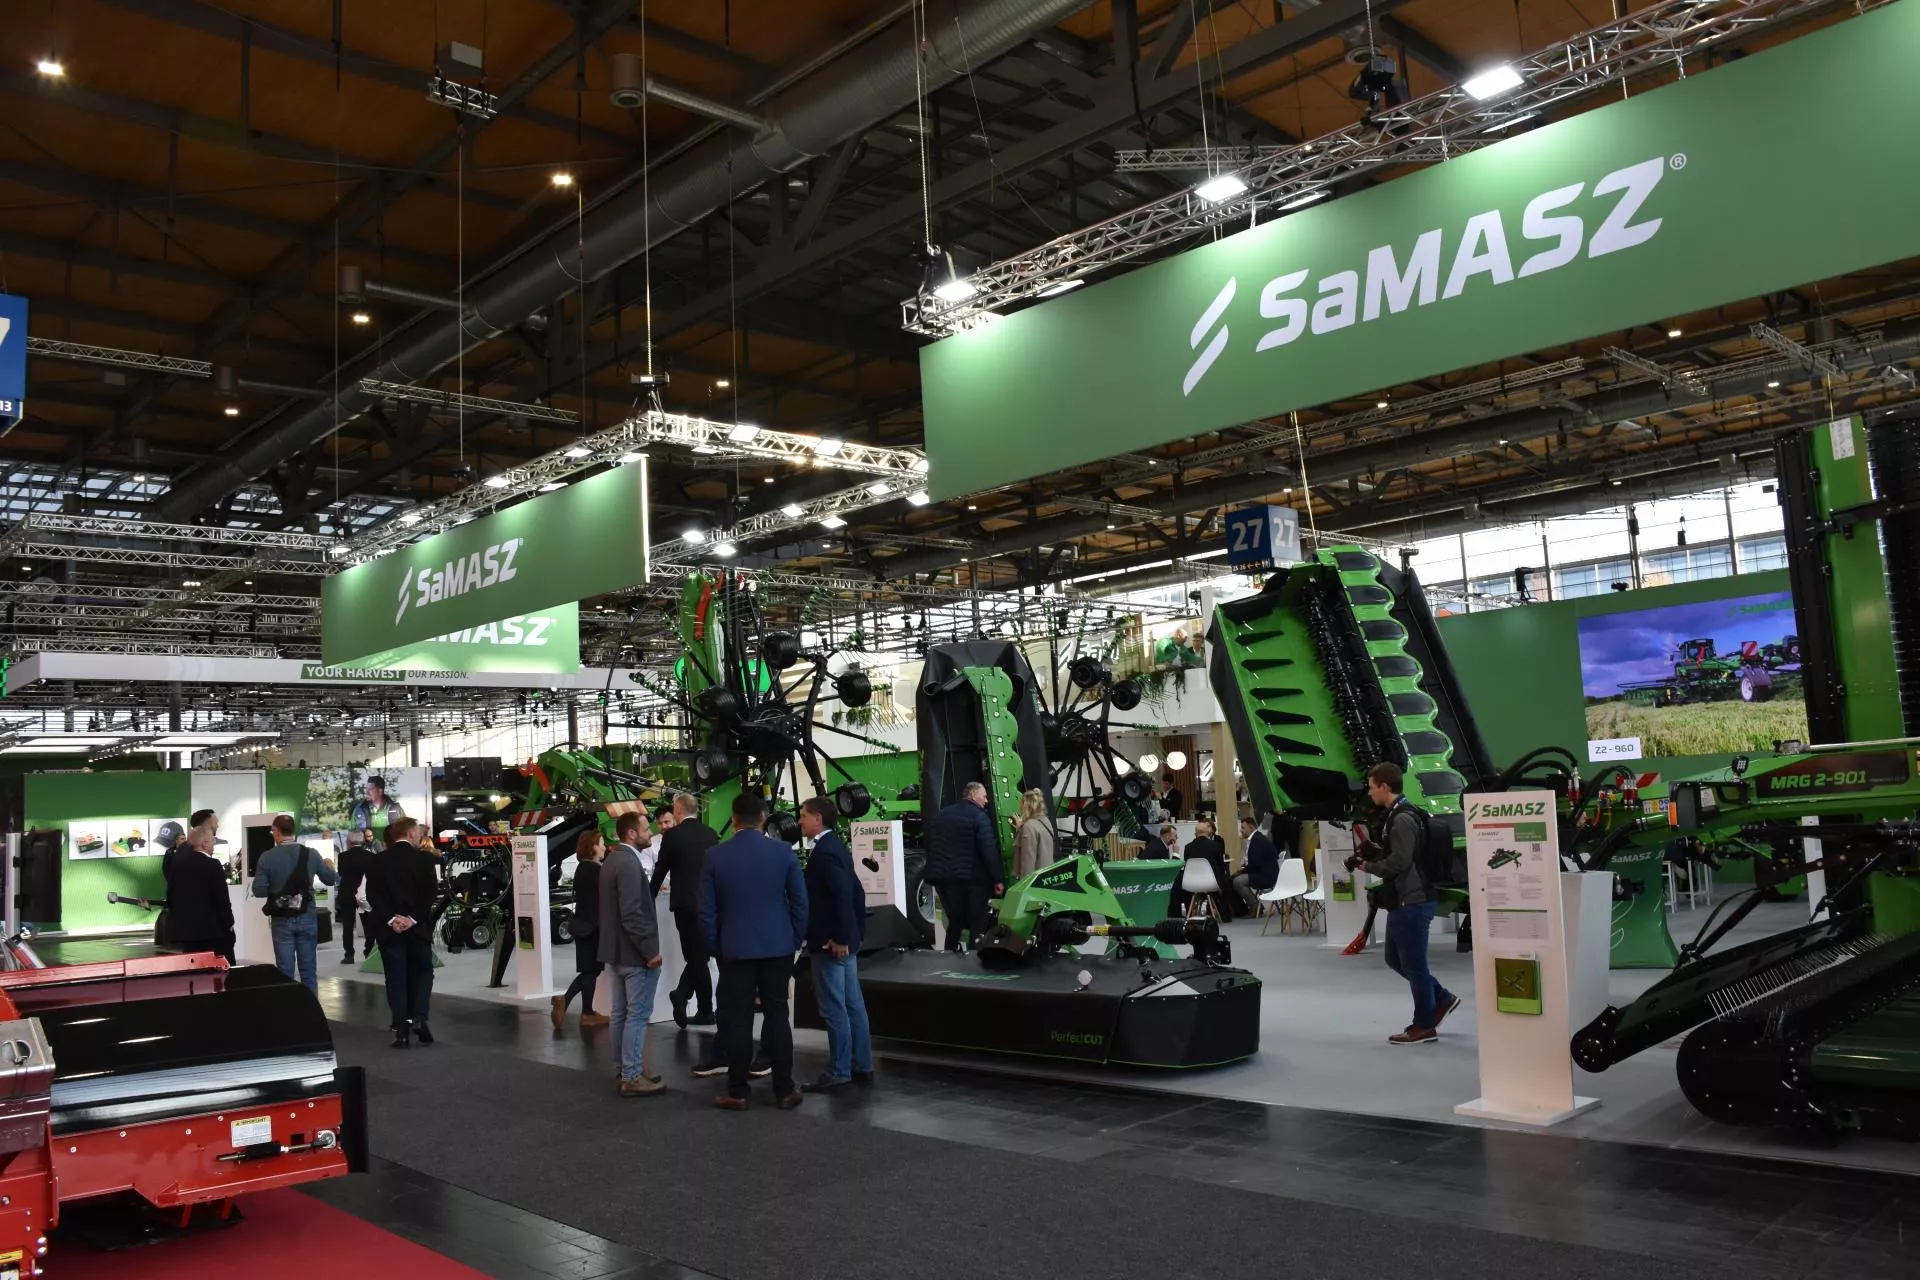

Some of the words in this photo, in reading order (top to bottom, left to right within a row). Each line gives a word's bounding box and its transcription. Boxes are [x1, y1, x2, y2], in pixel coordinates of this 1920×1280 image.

[1231, 517, 1264, 552] 27
[1273, 516, 1295, 548] 27
[306, 666, 343, 678] YOUR
[346, 667, 401, 679] HARVEST
[408, 670, 426, 679] OUR
[1595, 745, 1607, 754] Z2
[1615, 743, 1634, 753] 960
[1771, 774, 1811, 790] MRG
[1814, 770, 1867, 787] 2-901
[1482, 802, 1545, 818] SaMASZ
[860, 827, 888, 836] SaMASZ
[1610, 851, 1652, 864] SaMASZ
[1042, 875, 1059, 886] XT-F
[1059, 871, 1073, 881] 302
